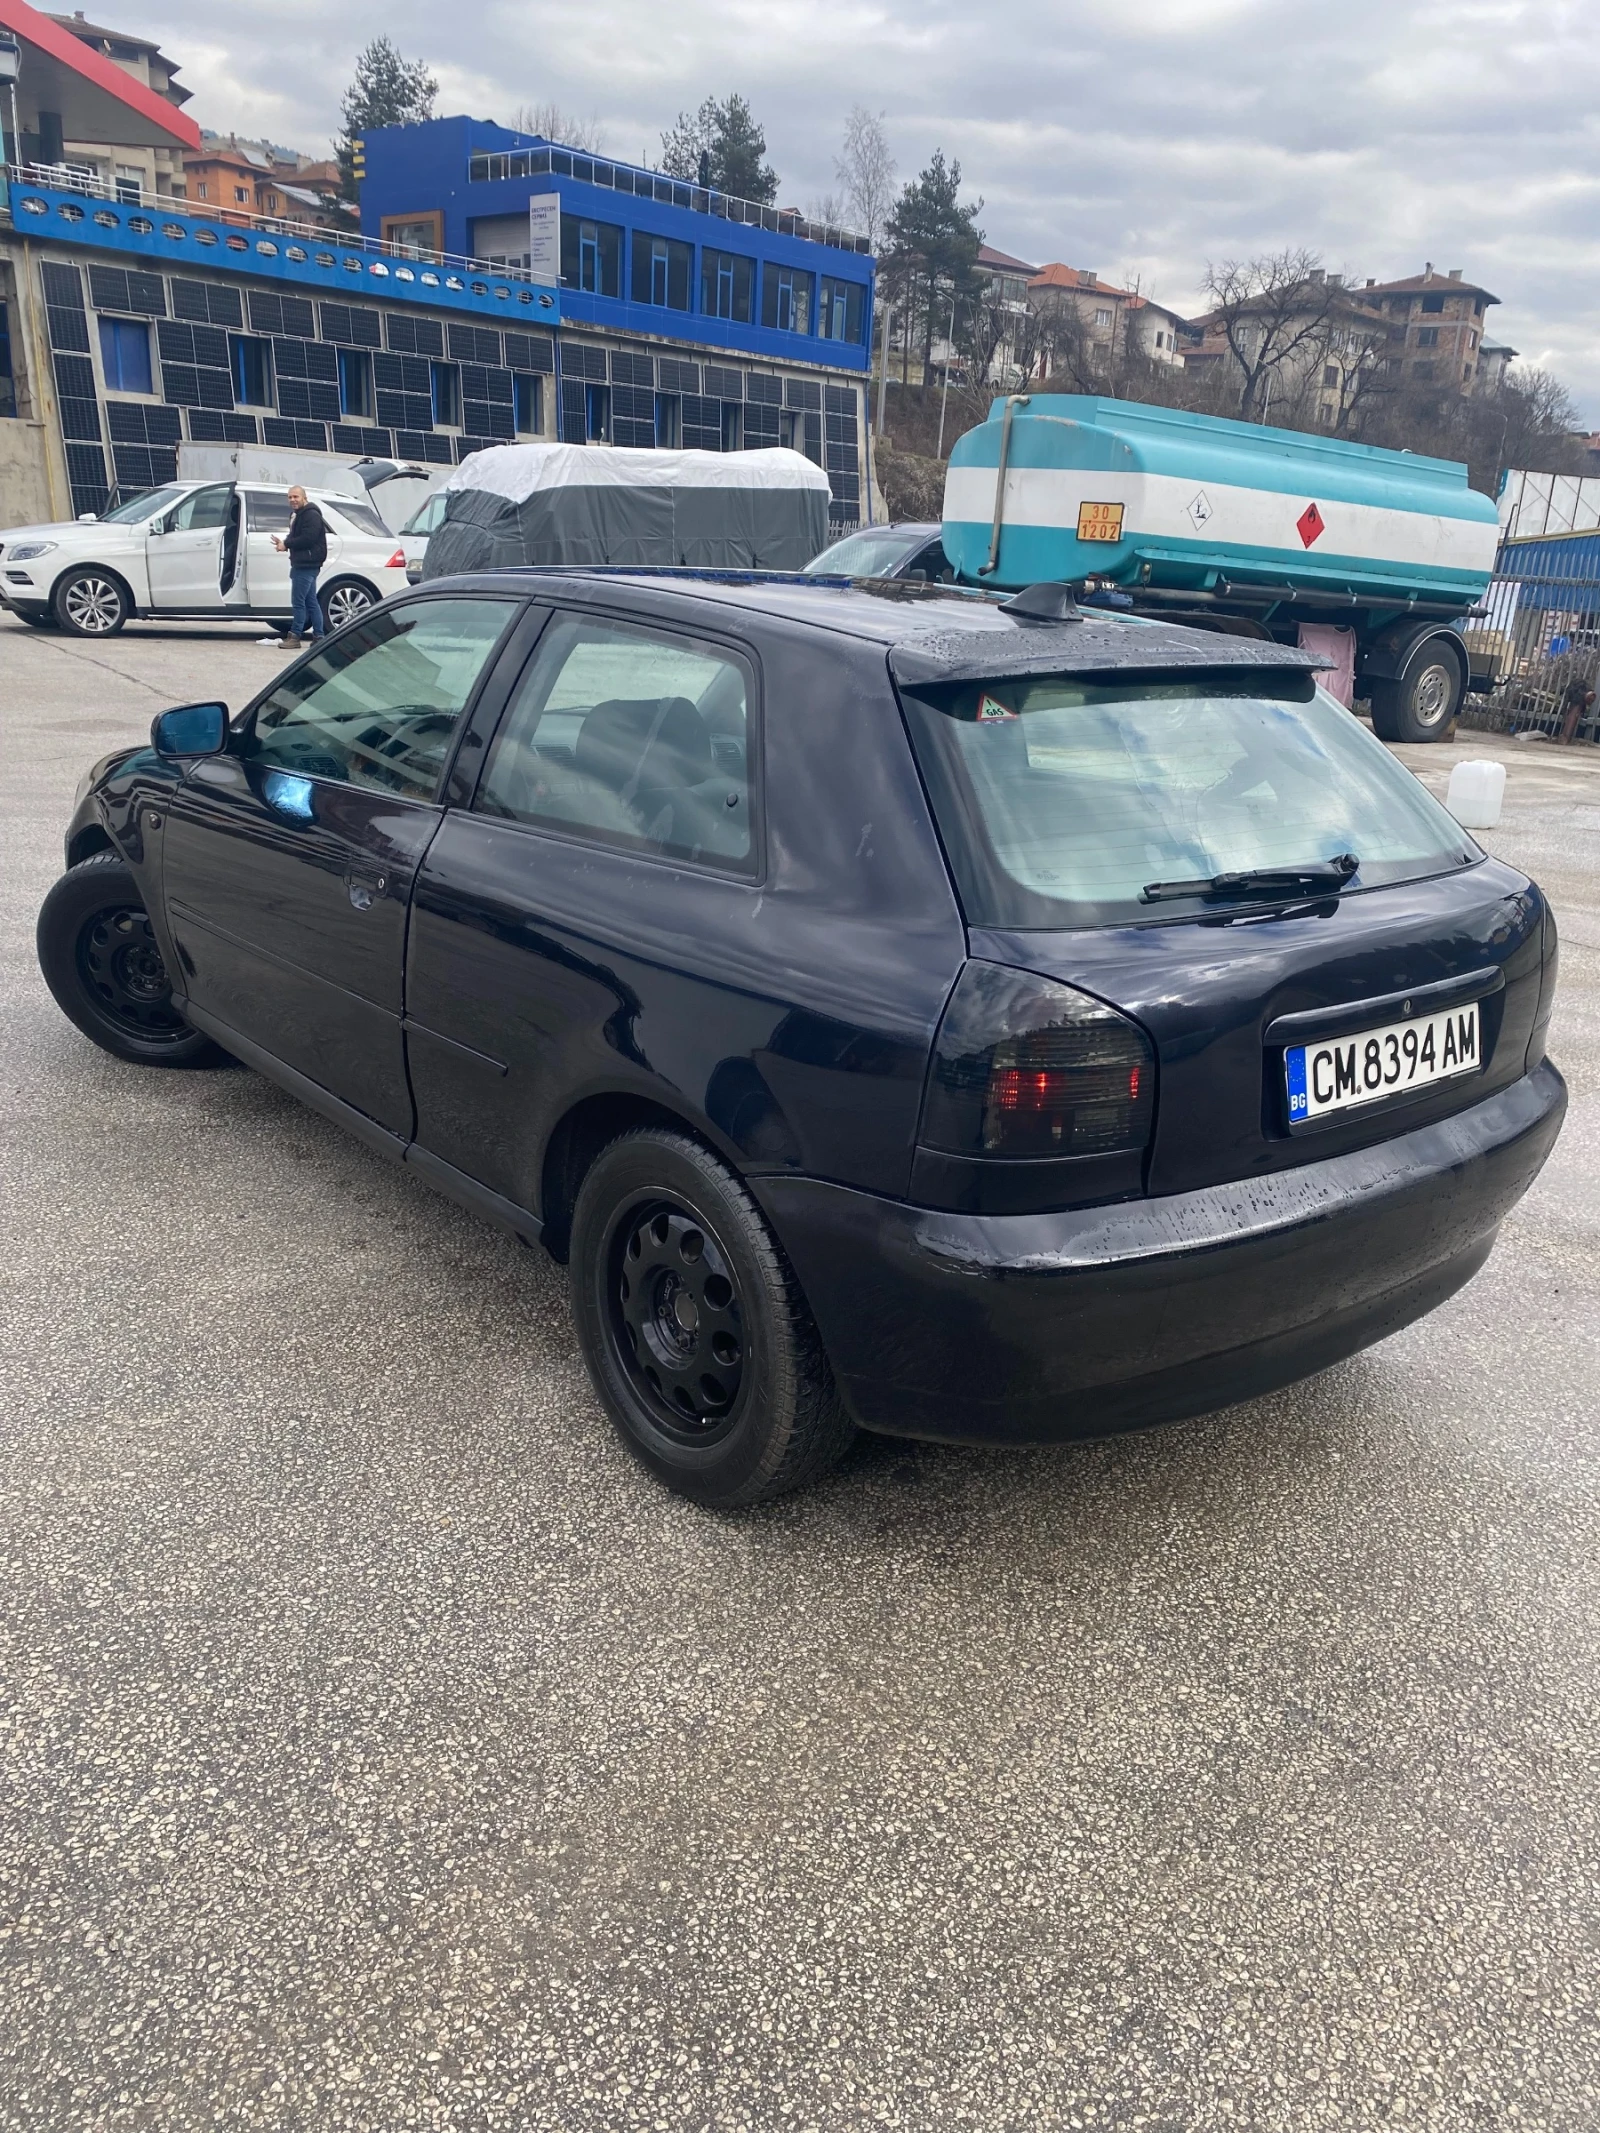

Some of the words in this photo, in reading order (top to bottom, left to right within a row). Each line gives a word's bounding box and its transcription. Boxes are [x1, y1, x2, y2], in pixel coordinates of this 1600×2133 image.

[1092, 505, 1109, 520] 30
[1082, 523, 1118, 540] 1202
[986, 707, 1004, 717] GAS
[1291, 1093, 1306, 1111] BG
